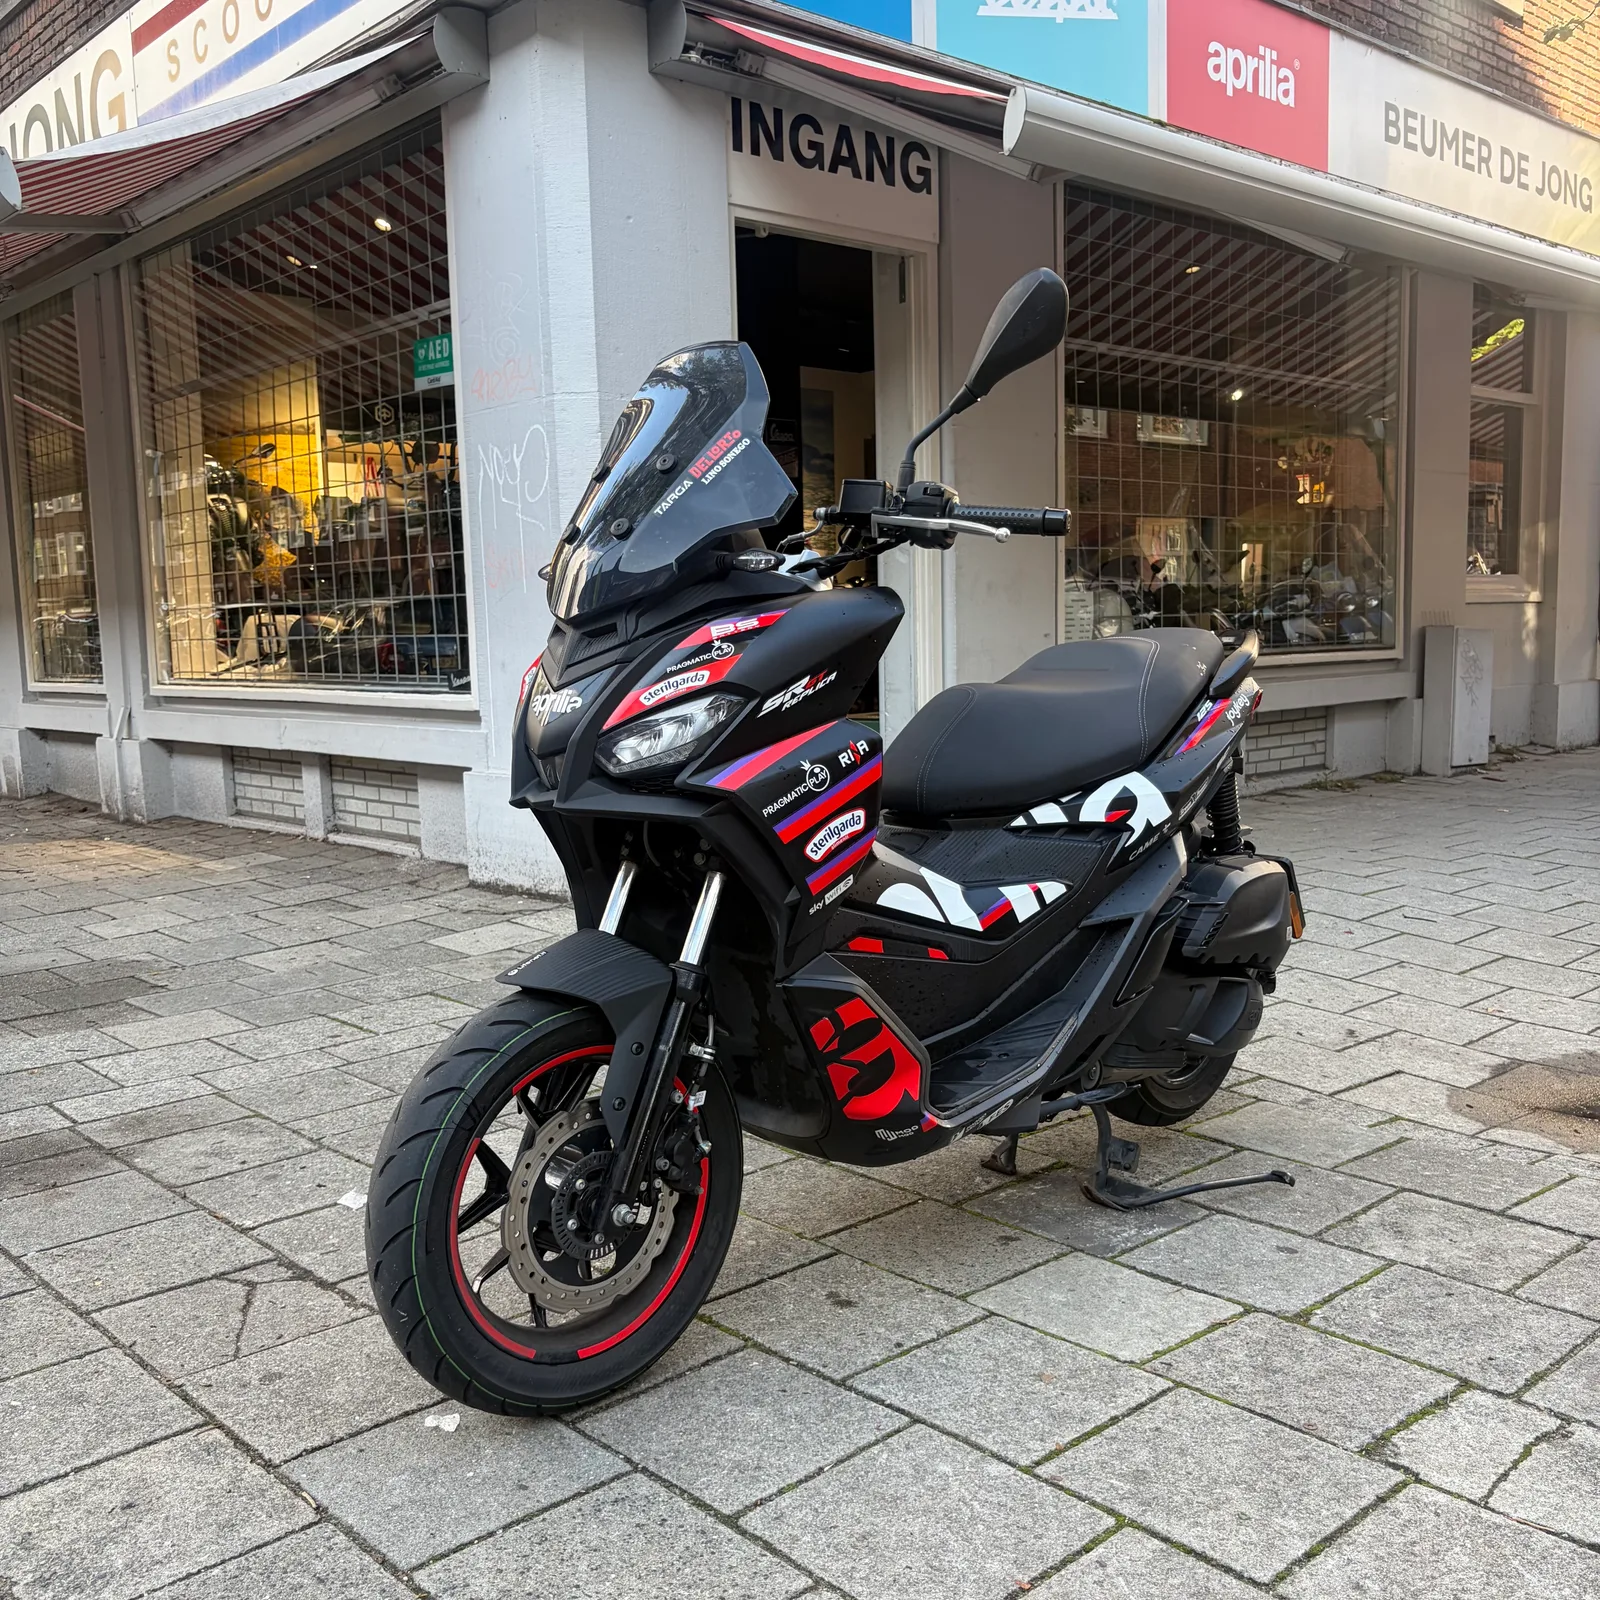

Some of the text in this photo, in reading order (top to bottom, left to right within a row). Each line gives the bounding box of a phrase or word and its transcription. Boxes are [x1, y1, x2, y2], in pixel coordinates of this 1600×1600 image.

[1207, 41, 1295, 108] aprilia
[731, 97, 932, 195] INGANG
[1384, 100, 1593, 214] BEUMER DE JONG
[428, 337, 450, 361] AED
[701, 465, 722, 486] LINO
[719, 437, 751, 468] SONEGO
[654, 479, 693, 516] TARGA
[711, 617, 759, 637] BS
[666, 645, 732, 674] PRAGMATIC PLAY
[643, 671, 705, 703] sterilgarda
[781, 671, 838, 712] REPLICA
[532, 689, 583, 727] aprilia
[1196, 699, 1213, 722] 125
[762, 769, 827, 818] PRAGMATIC PLAY
[810, 813, 862, 856] sterilgarda
[808, 885, 842, 916] sky wifi
